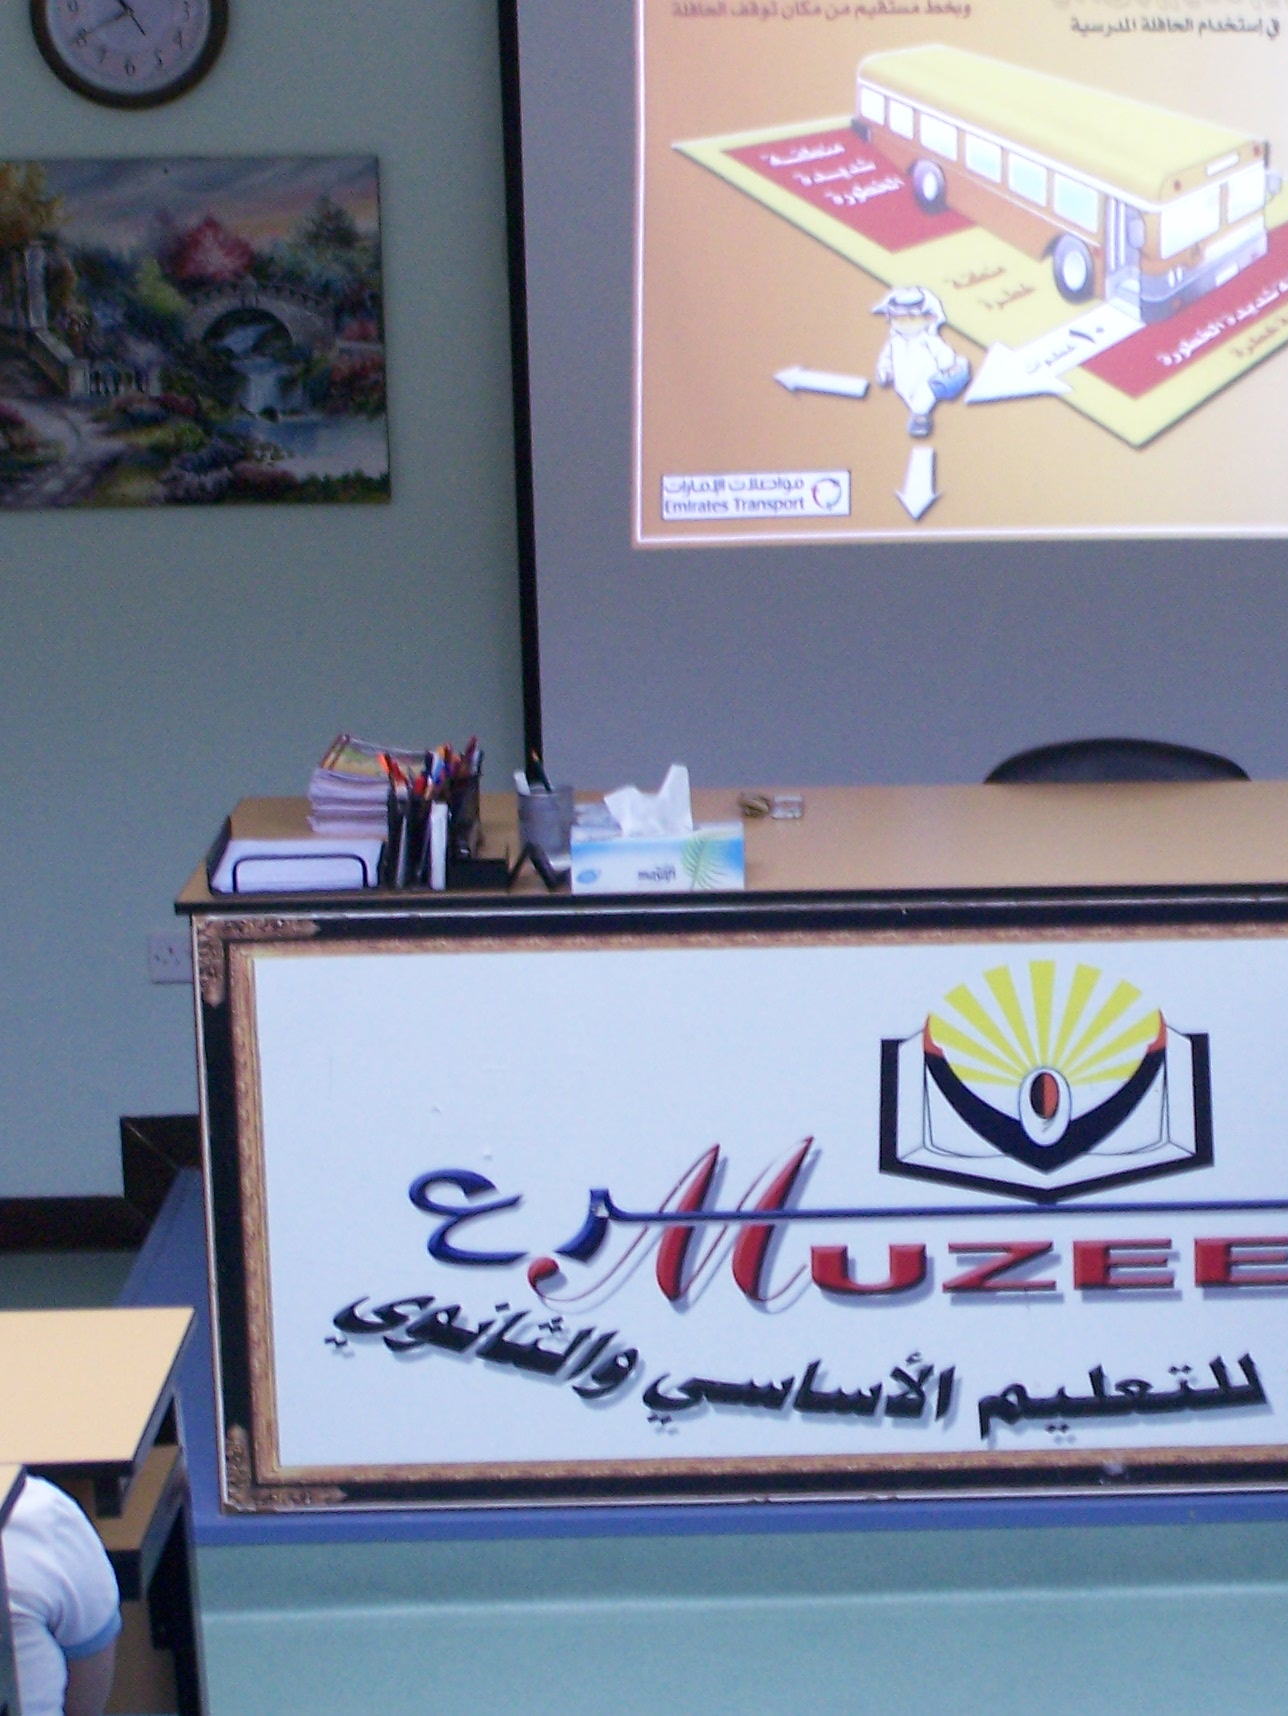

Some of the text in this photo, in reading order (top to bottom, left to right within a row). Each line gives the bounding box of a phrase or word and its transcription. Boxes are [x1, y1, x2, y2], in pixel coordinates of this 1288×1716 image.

[733, 496, 805, 515] Transport
[325, 1295, 640, 1400] والثانوي
[642, 1351, 956, 1427] الأساسي
[978, 1353, 1269, 1440] للتعليم
